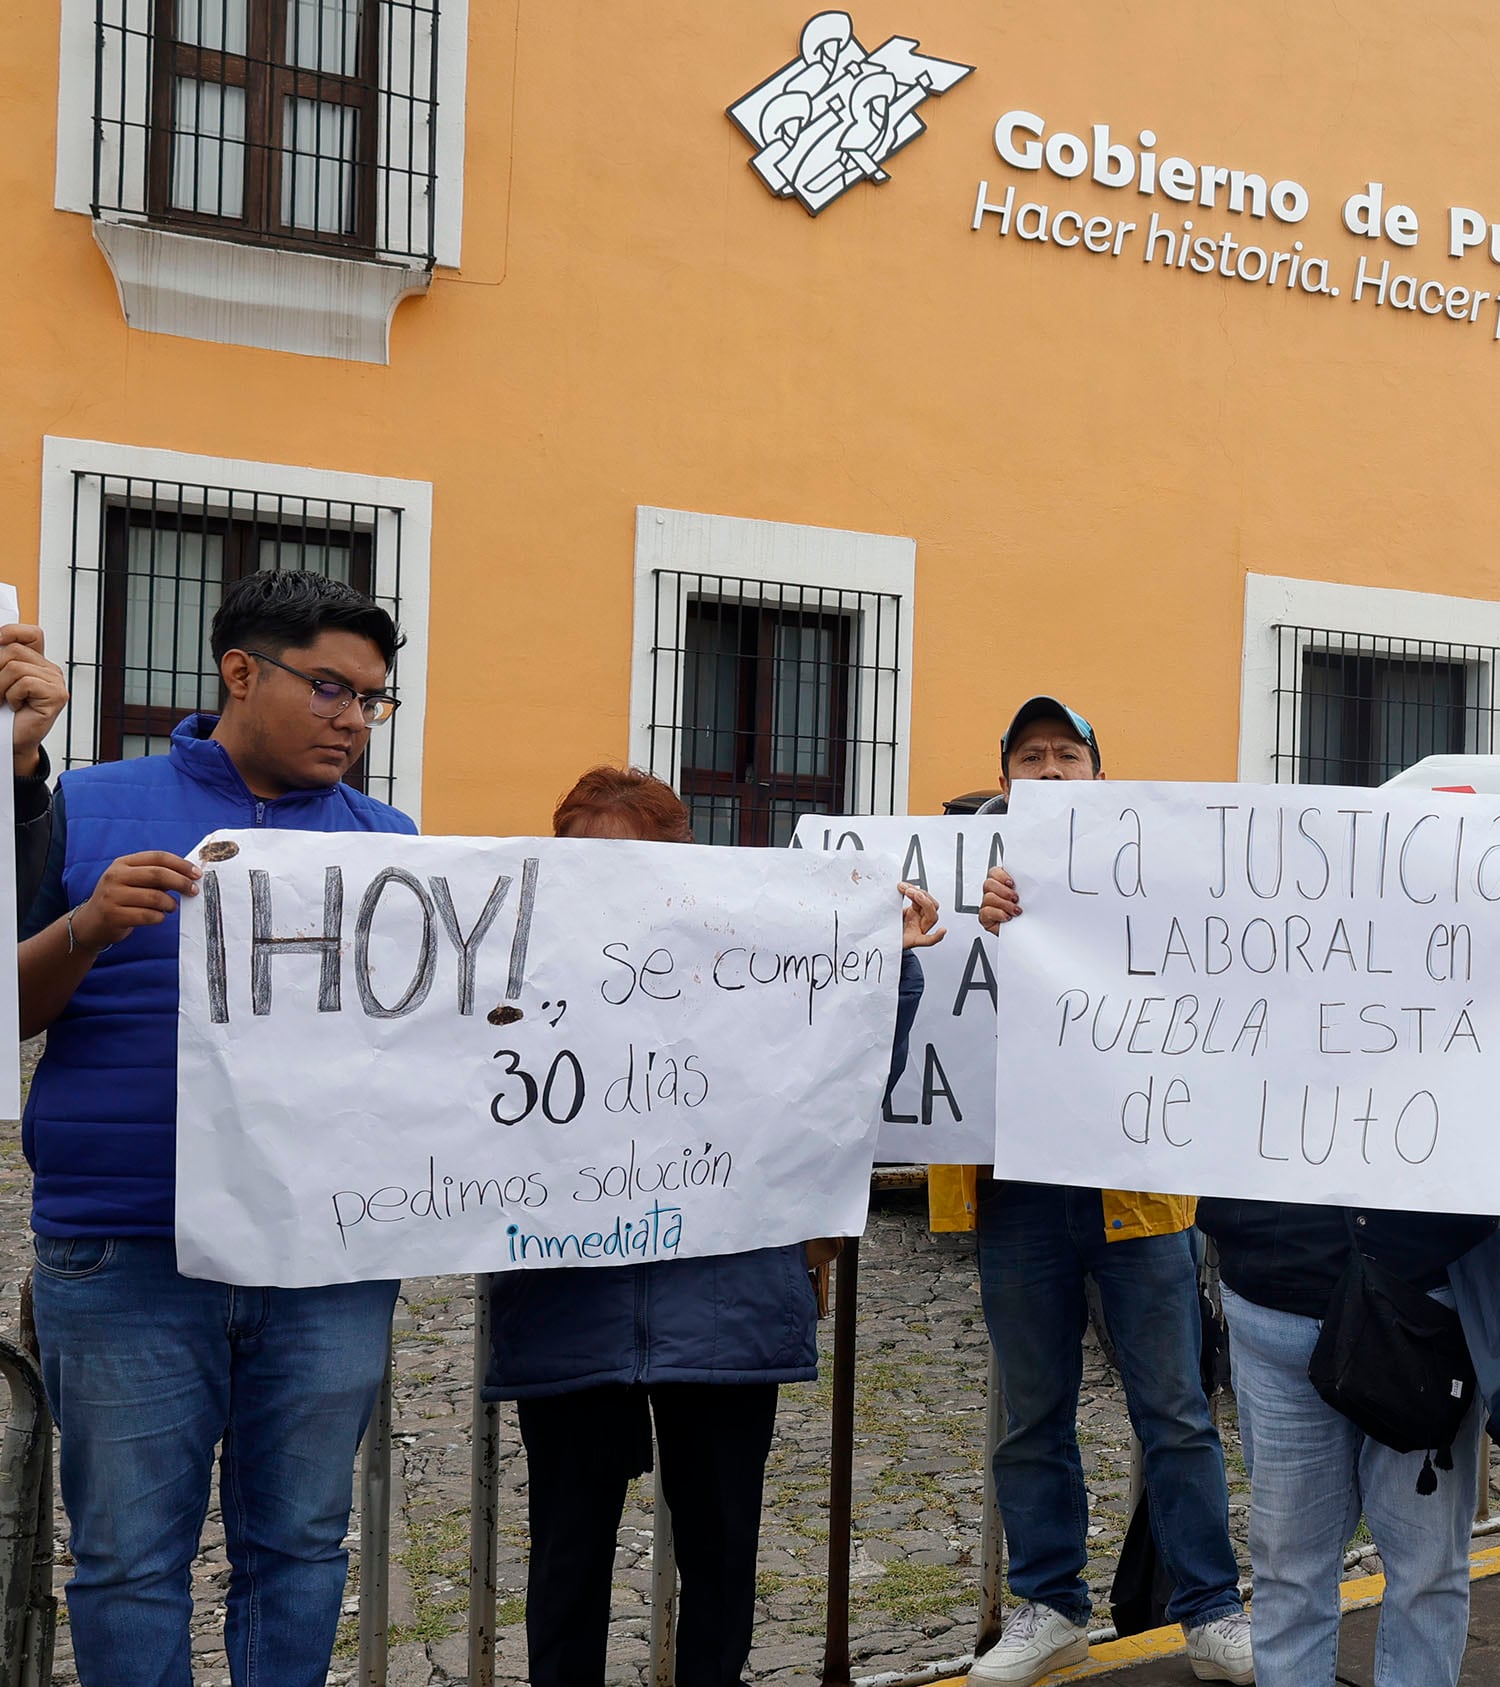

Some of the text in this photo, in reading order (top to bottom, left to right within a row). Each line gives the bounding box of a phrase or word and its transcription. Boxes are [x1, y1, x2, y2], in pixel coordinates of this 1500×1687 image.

[993, 110, 1309, 224] Gobierno
[1341, 182, 1418, 247] de
[971, 180, 1136, 256] Hacer
[1143, 212, 1341, 298] historia.
[1353, 255, 1489, 323] Hacer
[713, 910, 883, 1025] cumplen
[1126, 914, 1472, 982] LABORAL en
[1055, 987, 1481, 1056] PUEBLA ESTÁ
[490, 1050, 586, 1126] 30
[1121, 1075, 1192, 1147] de
[332, 1139, 733, 1250] pedimos solución
[506, 1198, 683, 1263] inmediata
